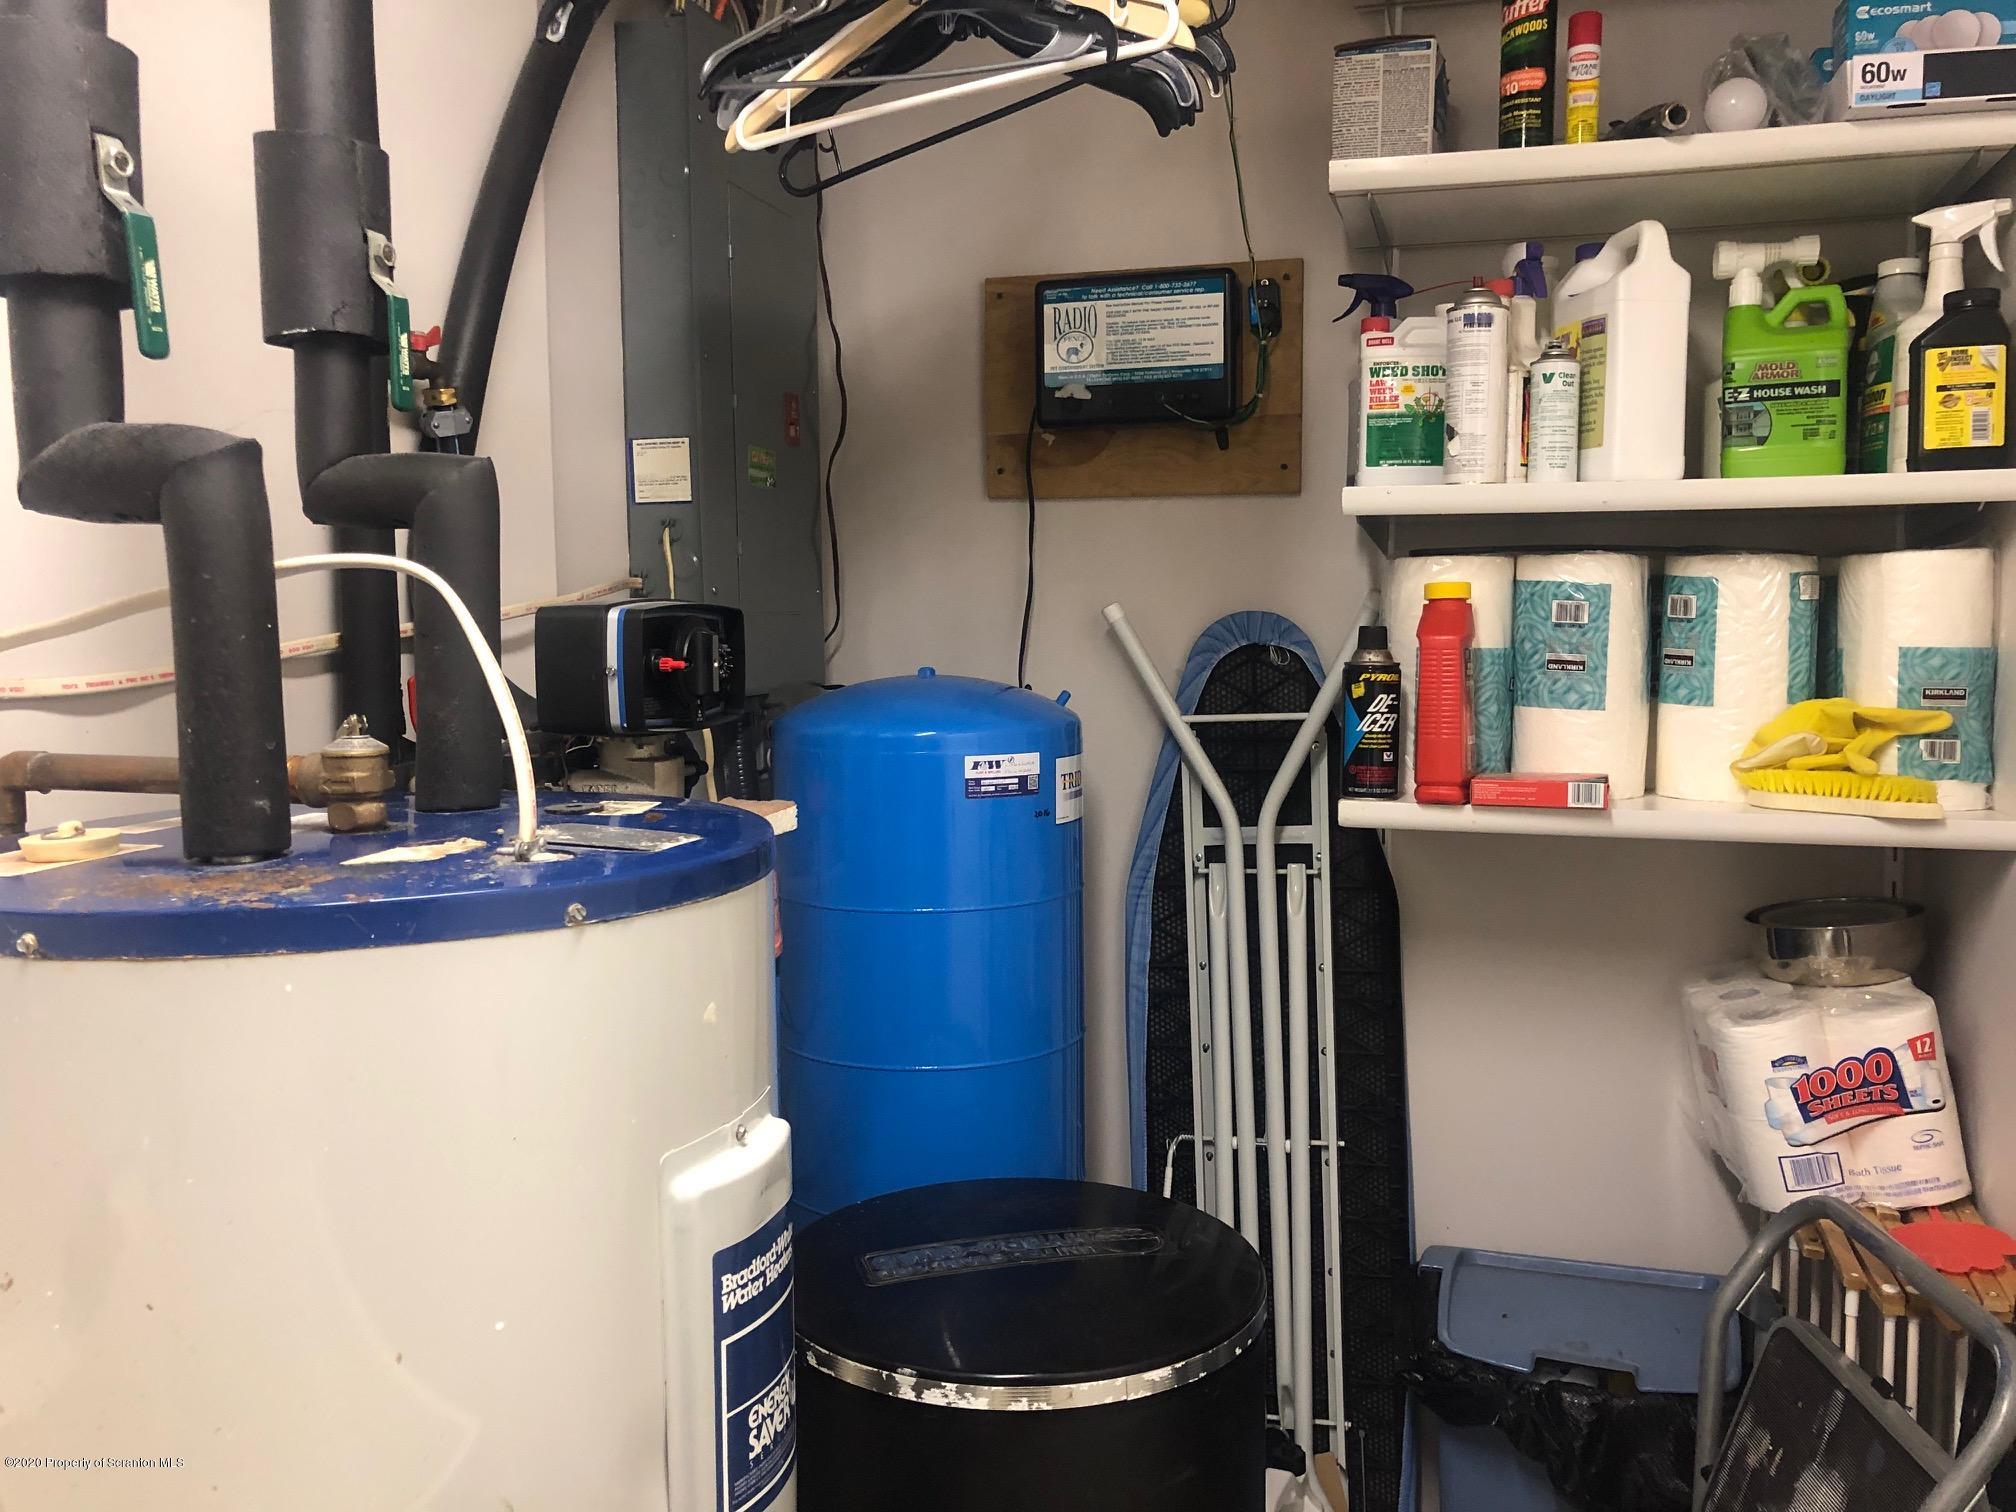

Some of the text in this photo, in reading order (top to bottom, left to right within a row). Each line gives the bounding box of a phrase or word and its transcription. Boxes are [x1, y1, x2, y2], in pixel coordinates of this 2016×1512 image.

[1870, 2, 1931, 16] ecosmart
[1505, 81, 1519, 96] 10
[1859, 92, 1896, 101] DAYLIGHT
[1053, 304, 1098, 342] RADIO
[1751, 369, 1800, 381] ARMOR
[1757, 361, 1797, 372] MOLD
[1724, 384, 1827, 402] E-Z HOUSE WASH
[1366, 693, 1398, 712] DE-
[1356, 713, 1398, 732] ICER
[1915, 1036, 1933, 1054] 12
[1792, 1052, 1893, 1104] 1000
[1807, 1083, 1899, 1118] SHEETS
[1848, 1163, 1903, 1177] Bath Tissue
[721, 1276, 765, 1314] Water
[748, 1394, 791, 1460] SAVER
